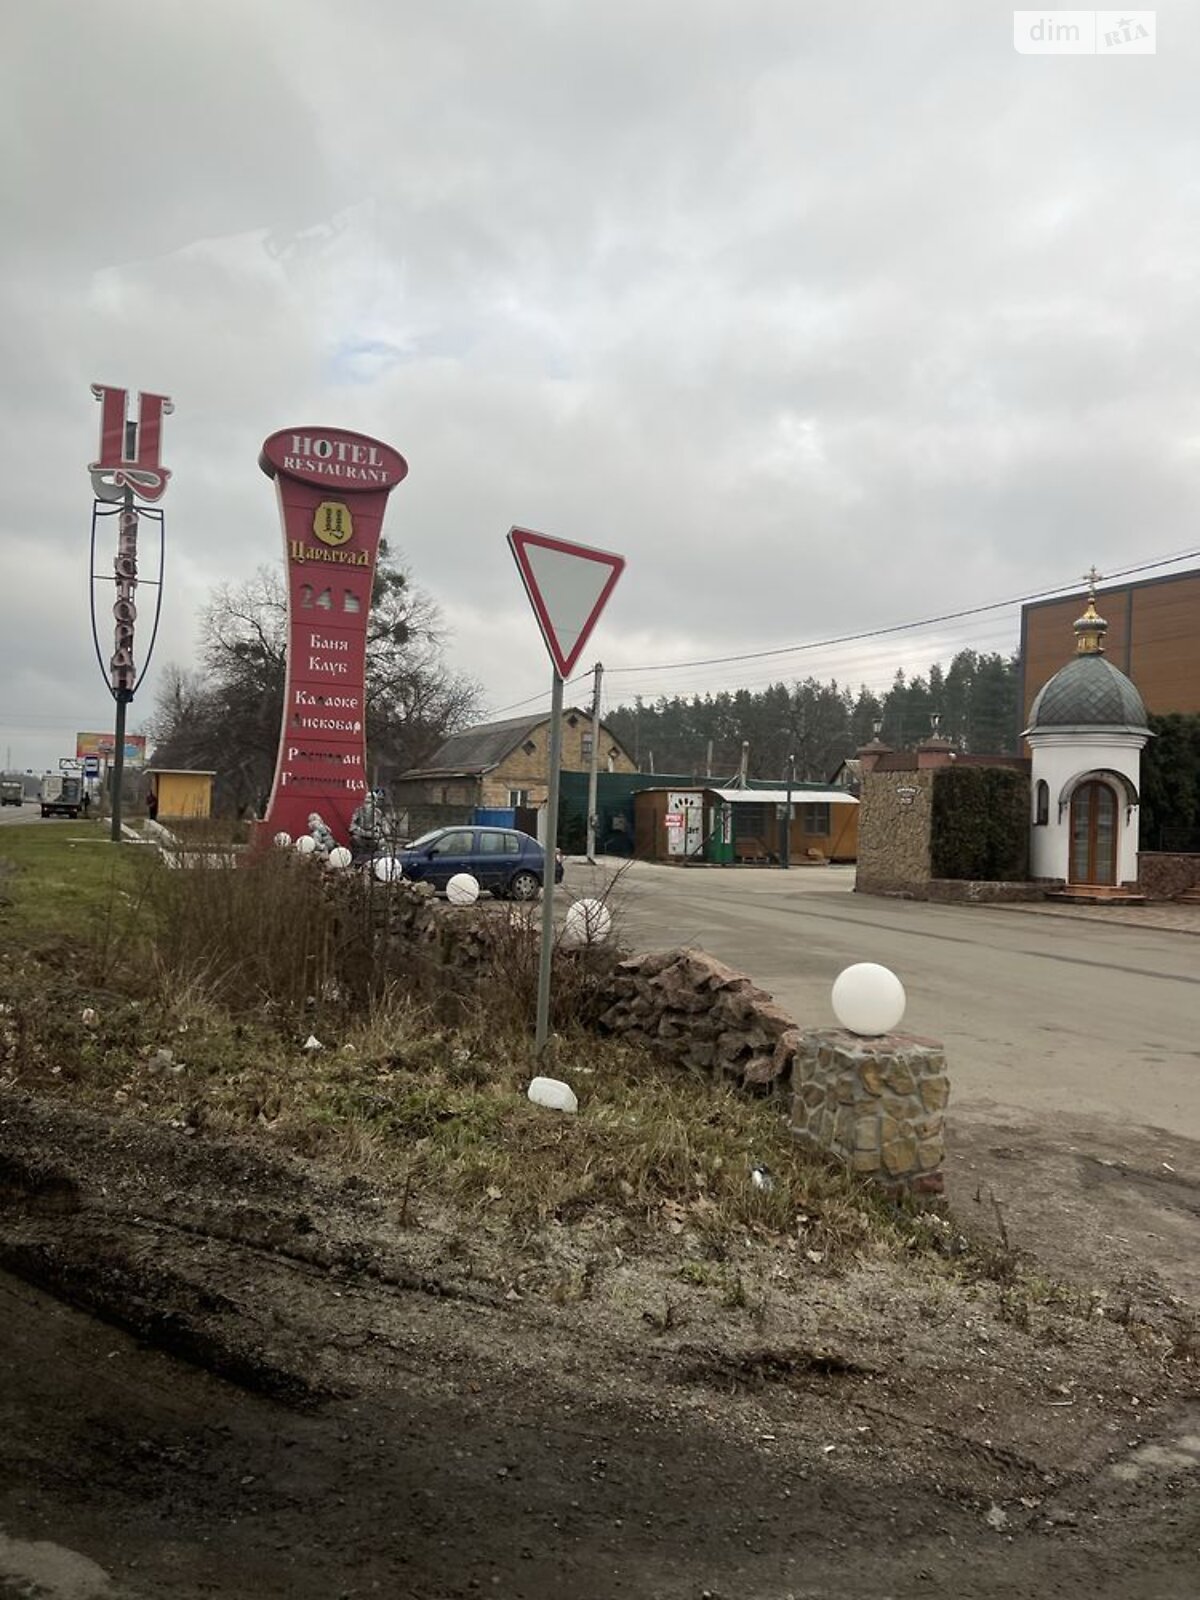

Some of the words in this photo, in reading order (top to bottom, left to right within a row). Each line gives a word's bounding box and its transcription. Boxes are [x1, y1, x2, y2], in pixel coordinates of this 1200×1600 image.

[291, 434, 383, 467] HOTEL
[284, 457, 390, 483] RESTAURANT
[300, 584, 333, 610] 24
[311, 634, 349, 651] Баня
[295, 690, 359, 709] Кааоке
